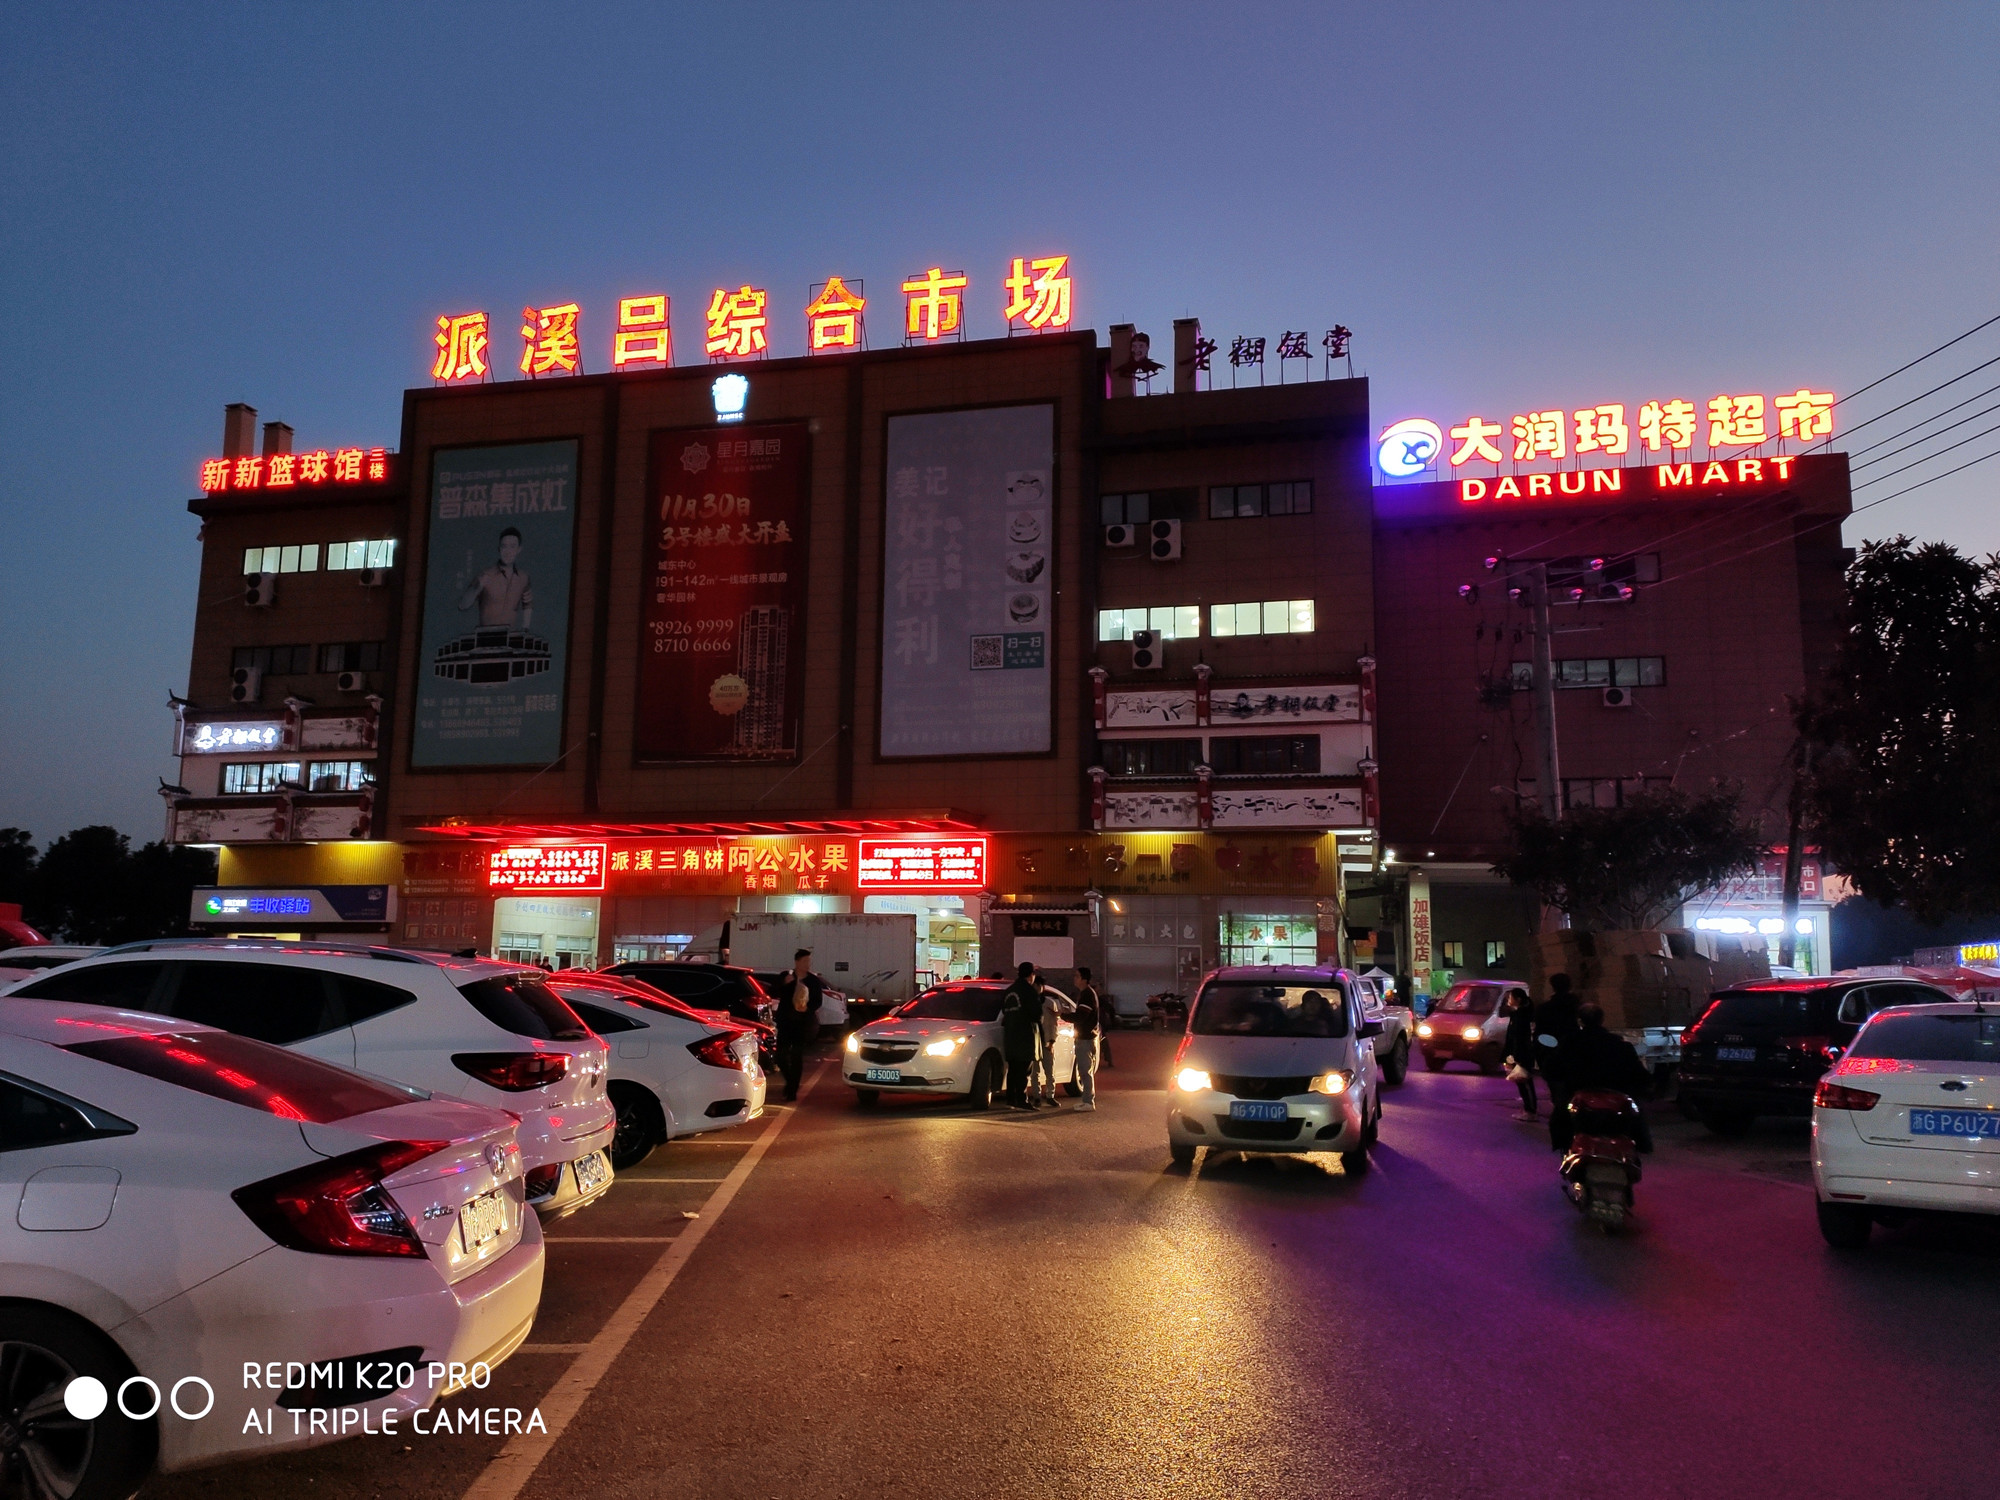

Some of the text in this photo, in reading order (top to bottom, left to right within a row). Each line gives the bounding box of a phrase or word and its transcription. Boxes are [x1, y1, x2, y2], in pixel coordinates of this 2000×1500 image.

[432, 254, 1072, 381] 派溪吕综合市场
[1449, 389, 1835, 466] 大润玛特超市
[716, 438, 782, 458] 星月嘉园
[201, 448, 366, 493] 新新篮球馆
[368, 448, 386, 479] 三楼
[1461, 455, 1797, 501] DARUN MART
[660, 493, 752, 520] 11月30日
[655, 619, 734, 635] 8926 9999
[654, 637, 731, 653] 8710 6666
[610, 849, 725, 872] 派溪三角饼
[727, 843, 850, 873] 阿公水果
[744, 873, 830, 889] 香烟 瓜子
[249, 896, 312, 915] 丰收驿站
[1248, 925, 1288, 941] 水果
[1413, 898, 1431, 962] 加雄饭店
